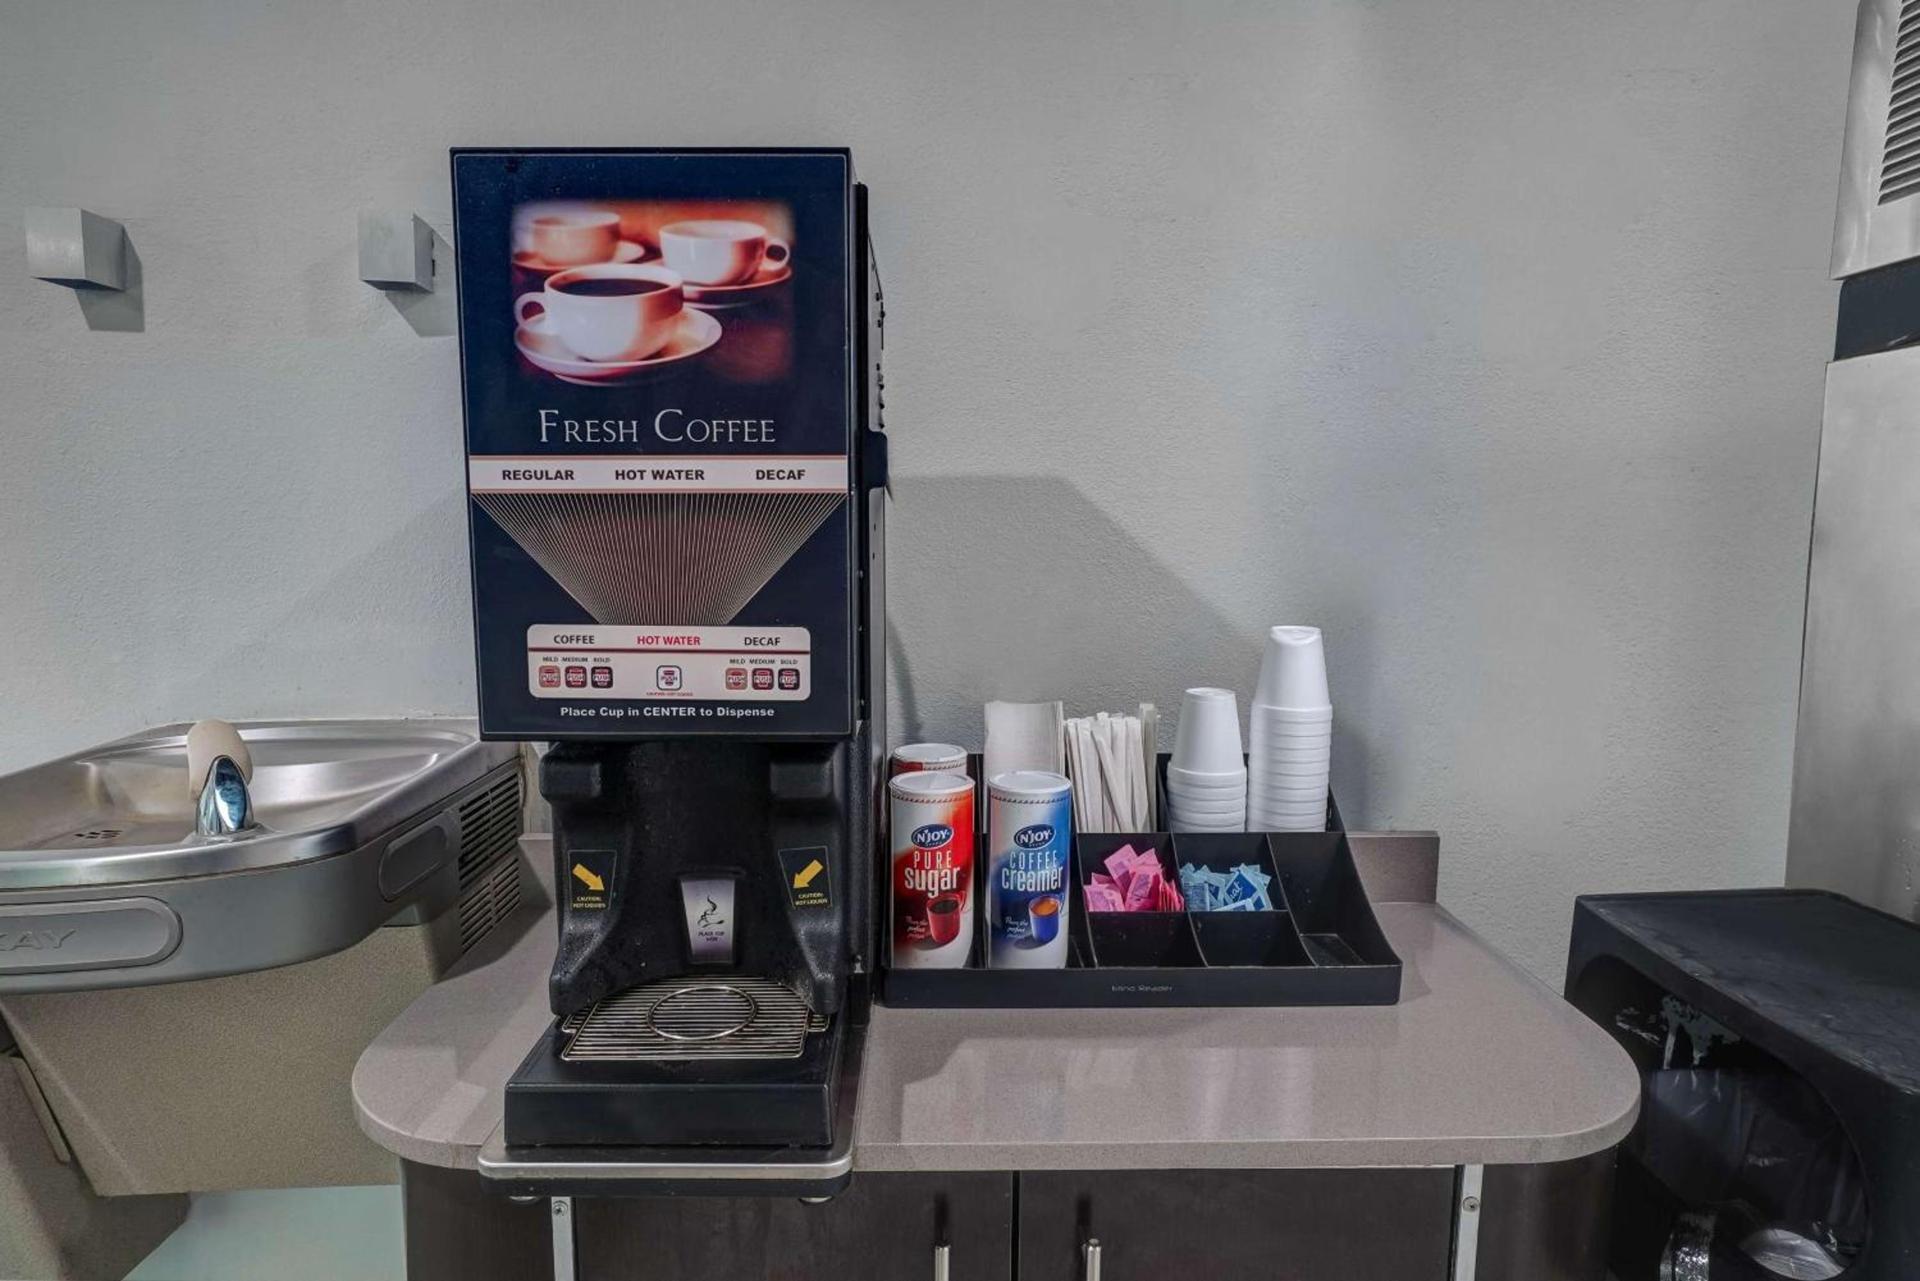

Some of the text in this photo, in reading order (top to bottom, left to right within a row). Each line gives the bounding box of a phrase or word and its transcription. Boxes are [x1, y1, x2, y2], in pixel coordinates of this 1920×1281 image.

[502, 469, 575, 481] REGULAR
[615, 469, 705, 481] HOT WATER
[755, 469, 806, 481] DECAF
[553, 634, 595, 645] COFFEE
[636, 635, 701, 646] HOT WATER
[744, 636, 781, 646] DECAF
[560, 707, 775, 719] Place Cup in CENTER to Dispense
[914, 851, 952, 869] PURE
[1010, 851, 1057, 869] COFFEE
[905, 867, 961, 898] sugar
[1002, 867, 1063, 891] creamer
